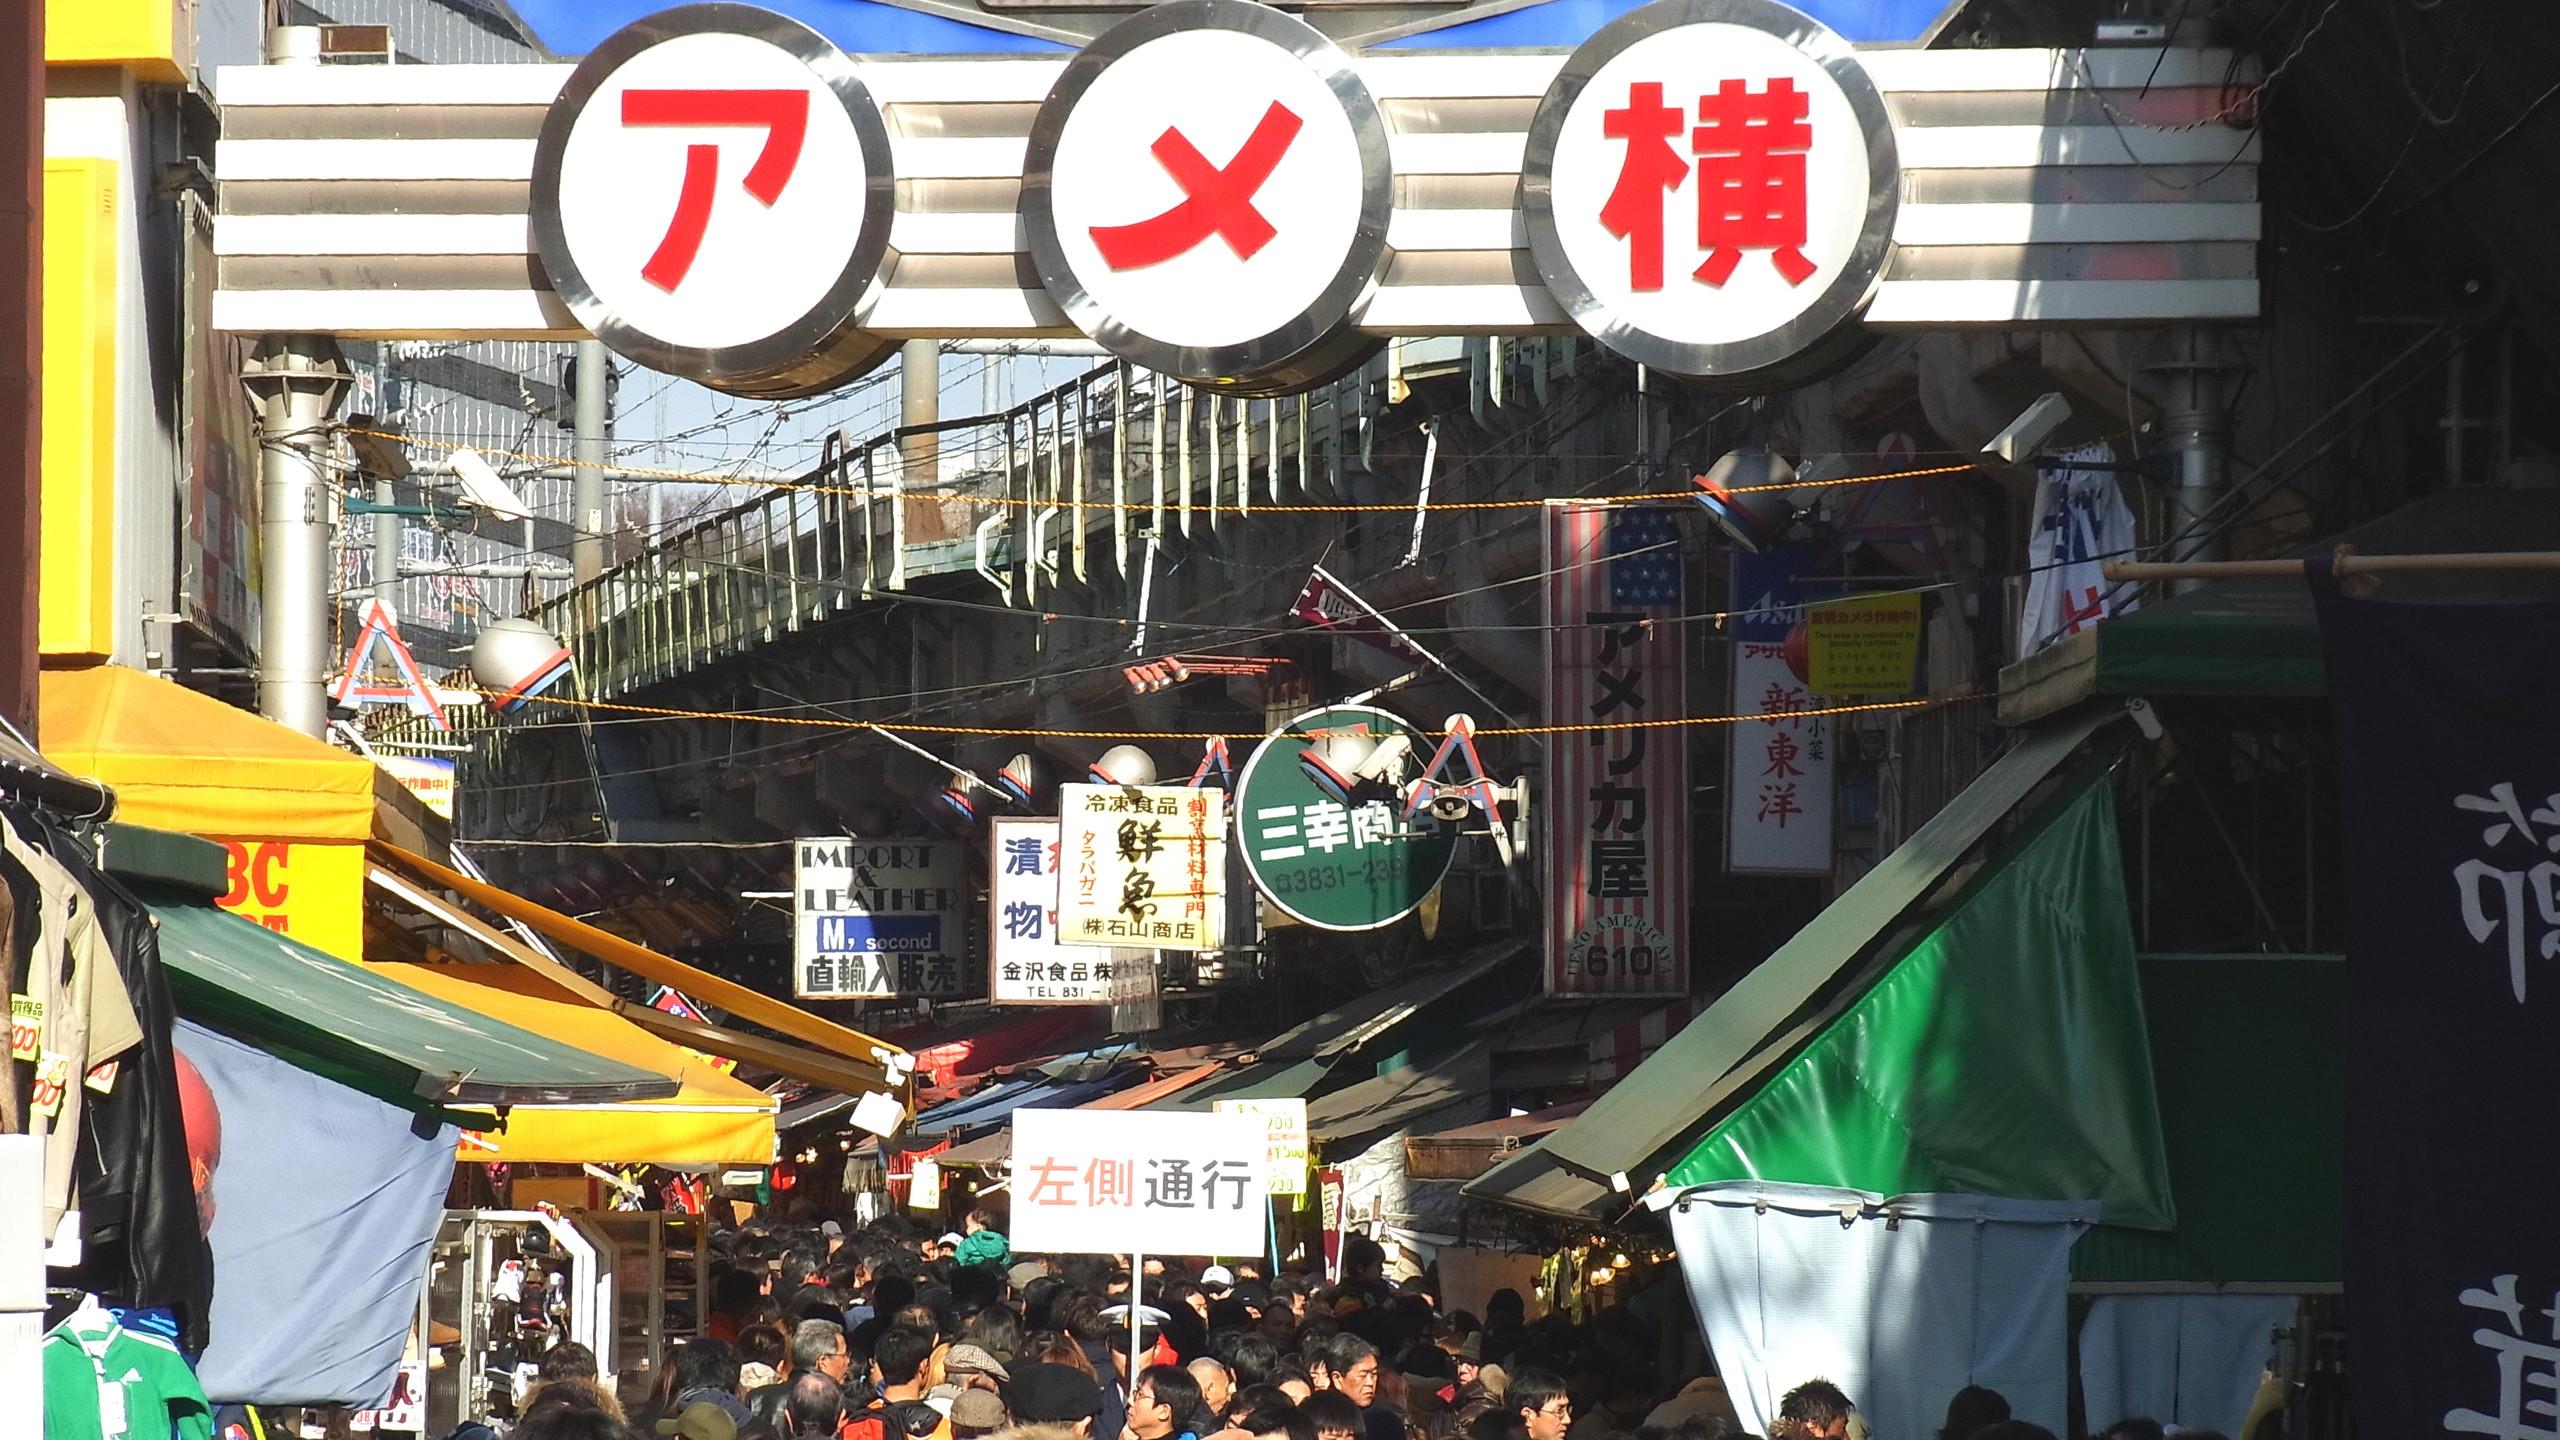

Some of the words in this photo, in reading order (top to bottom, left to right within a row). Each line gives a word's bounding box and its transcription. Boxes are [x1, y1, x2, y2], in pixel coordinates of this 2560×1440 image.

[620, 77, 1816, 291] アメ横
[1586, 611, 1649, 898] アメリカ屋
[1758, 682, 1806, 828] 新東洋
[1085, 794, 1178, 816] 冷凍食品
[801, 845, 935, 869] IMPORT
[854, 865, 878, 888] &
[1078, 830, 1097, 906] タラバガニ
[1116, 818, 1165, 916] 鮮魚
[804, 888, 959, 912] LEATHER
[1004, 837, 1042, 940] 漬物
[866, 932, 932, 949] second
[1587, 945, 1653, 976] 610
[806, 952, 958, 993] 直輸入販売
[1028, 986, 1056, 998] TEL
[1028, 1156, 1252, 1210] 左側通行
